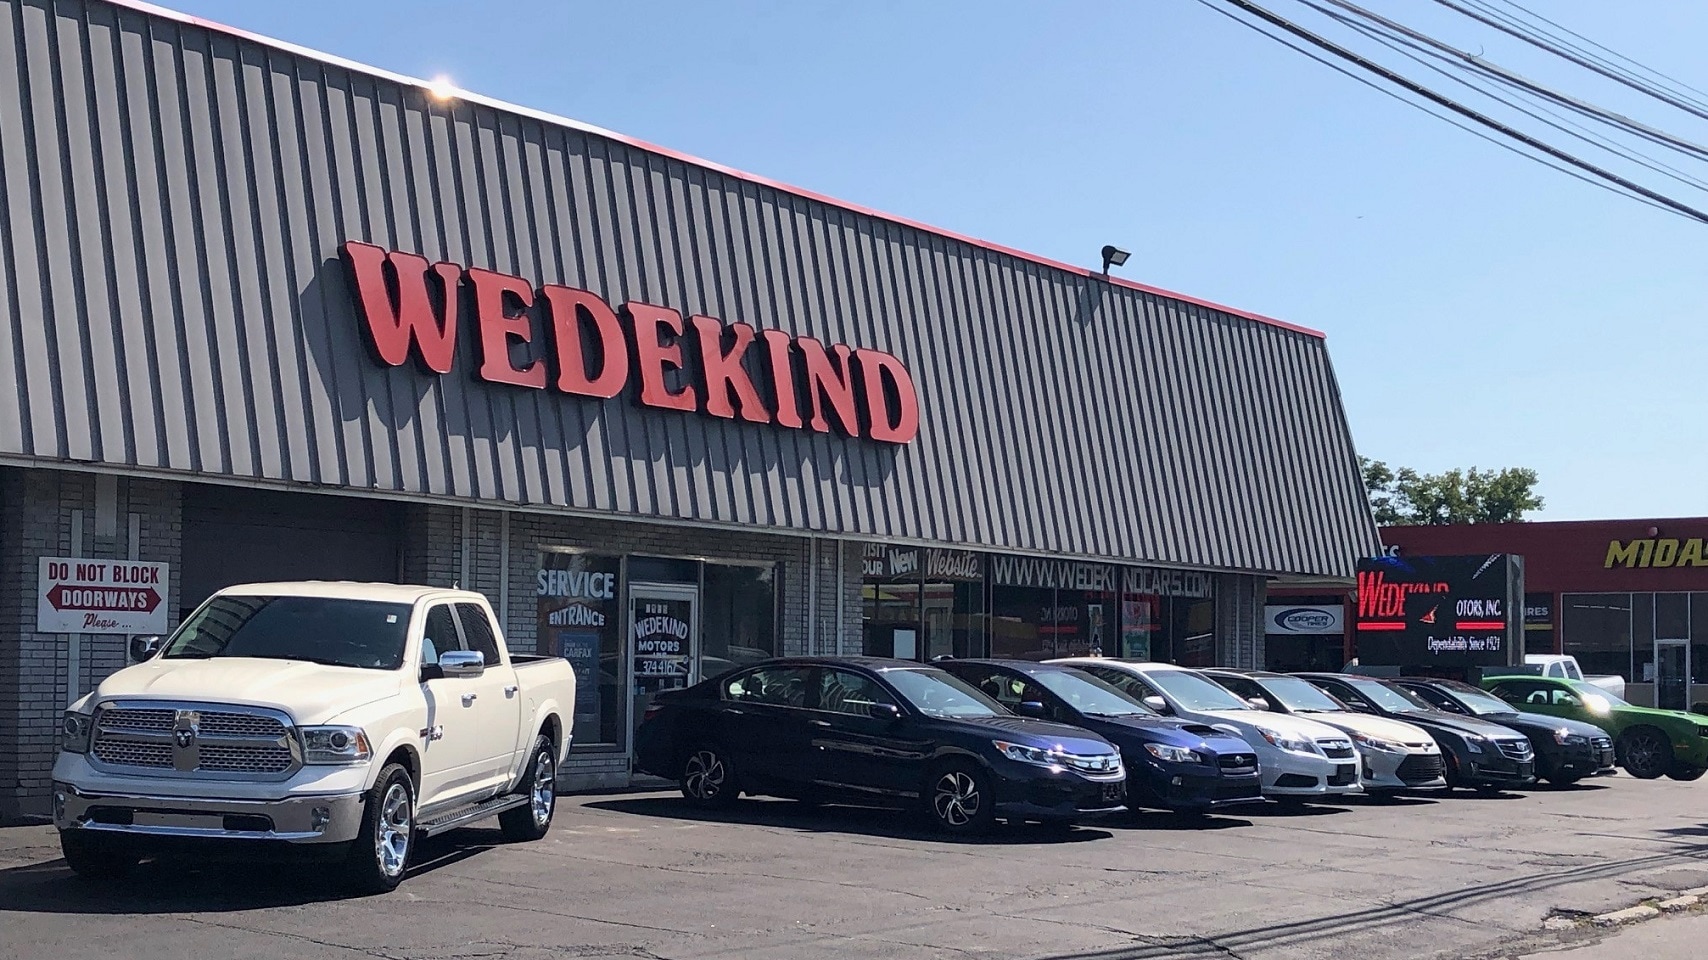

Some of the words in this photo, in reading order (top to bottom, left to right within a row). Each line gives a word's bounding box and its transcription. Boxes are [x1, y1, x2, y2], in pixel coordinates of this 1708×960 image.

[340, 240, 921, 445] WEDEKIND
[1604, 538, 1708, 568] MIDA
[49, 562, 68, 580] DO
[77, 564, 106, 582] NOT
[113, 565, 159, 584] BLOCK
[537, 569, 615, 599] SERVICE
[62, 590, 148, 609] DOORWAYS
[1456, 599, 1484, 618] OTORS,
[549, 604, 605, 627] ENTRANCE
[1524, 607, 1548, 616] IRES
[634, 616, 688, 640] WEDEKIND
[563, 647, 593, 658] CARFAX
[638, 640, 680, 652] MOTORS
